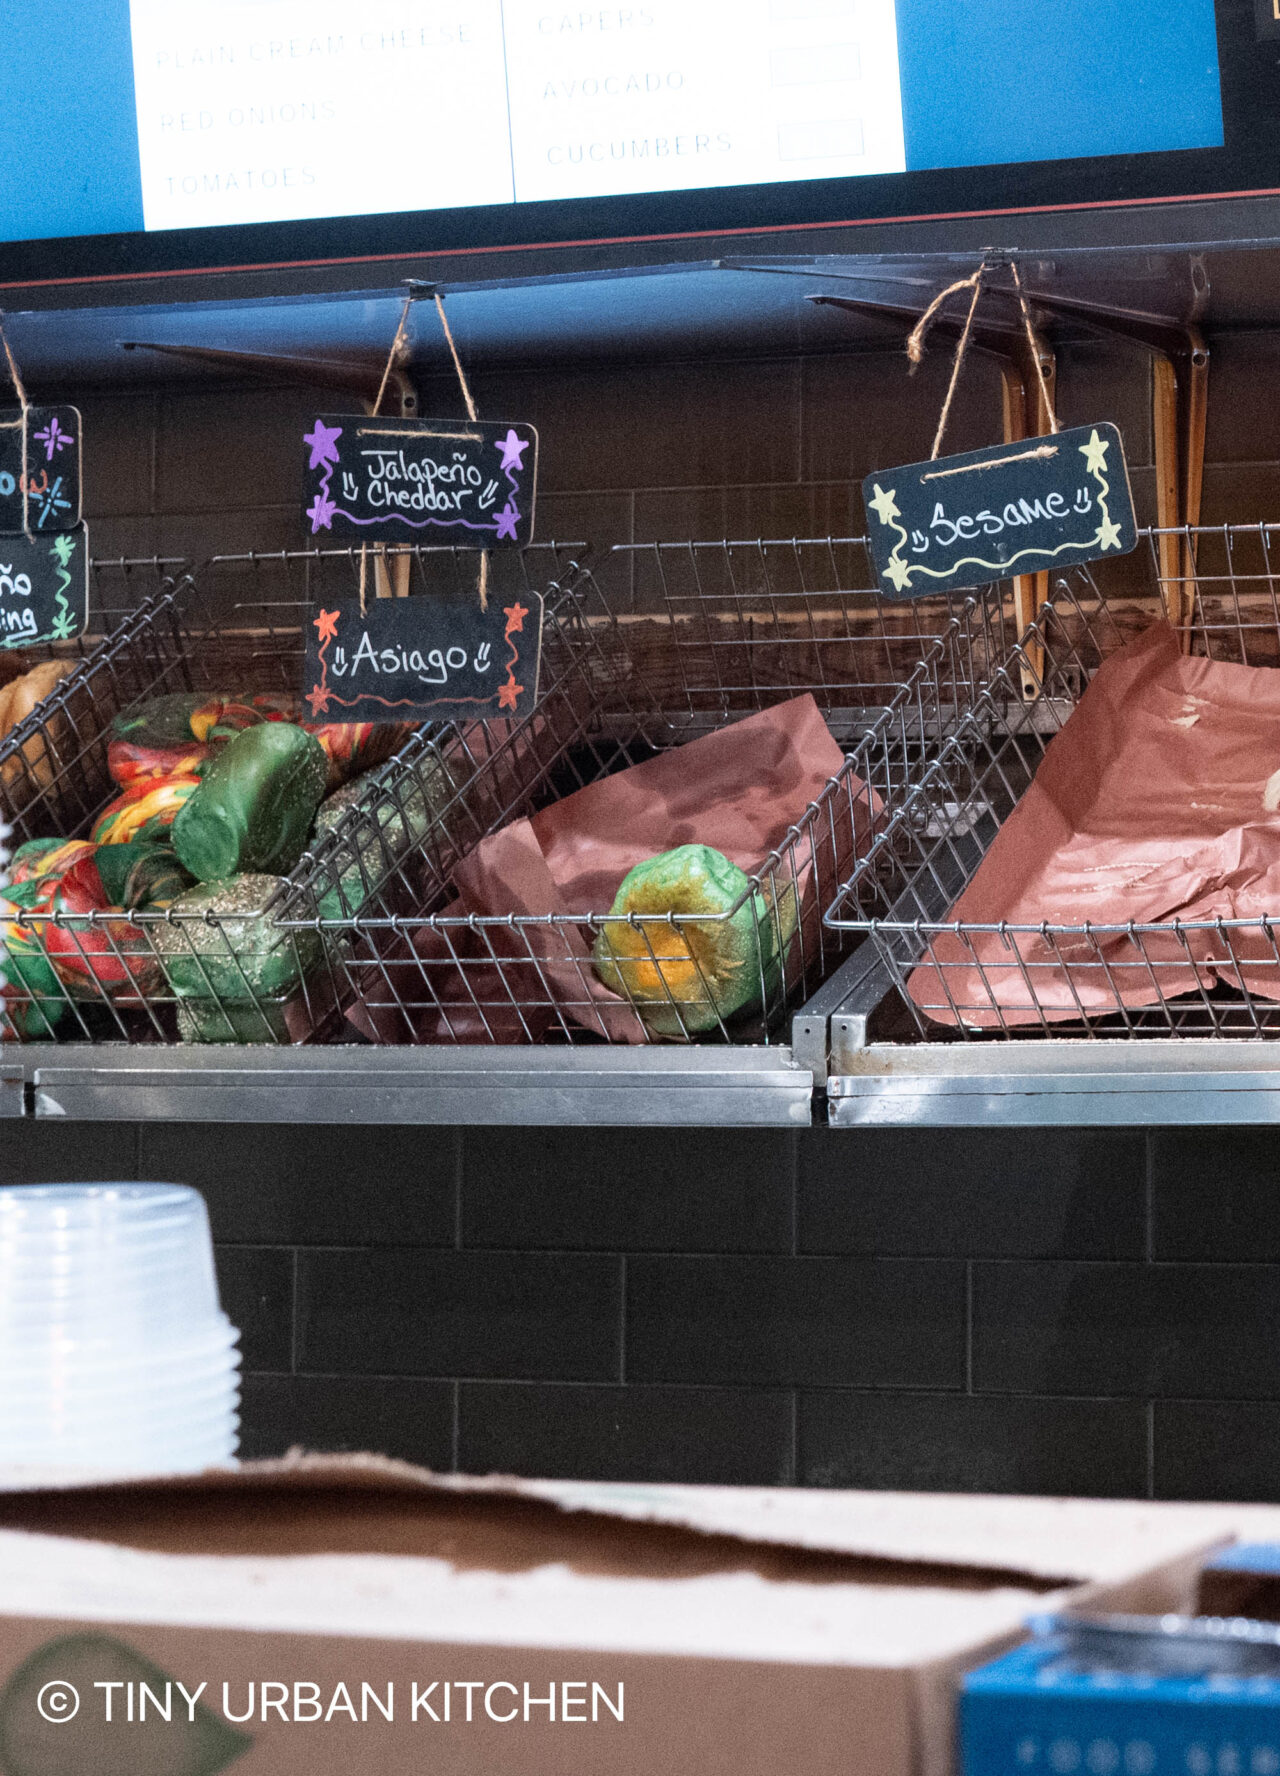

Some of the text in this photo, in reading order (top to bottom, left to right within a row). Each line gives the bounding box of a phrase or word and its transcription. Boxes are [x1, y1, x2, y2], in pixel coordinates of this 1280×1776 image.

[537, 8, 656, 36] CAPERS
[153, 22, 473, 70] PLAIN CREAM CHEESE
[542, 69, 686, 101] AVOCADO
[160, 99, 337, 135] RED ONIONS
[545, 131, 734, 166] CUCUMBERS
[165, 164, 318, 197] TOMATOES
[360, 449, 482, 487] Jalapeño
[367, 480, 473, 511] Cheddar
[351, 631, 468, 684] Asiago
